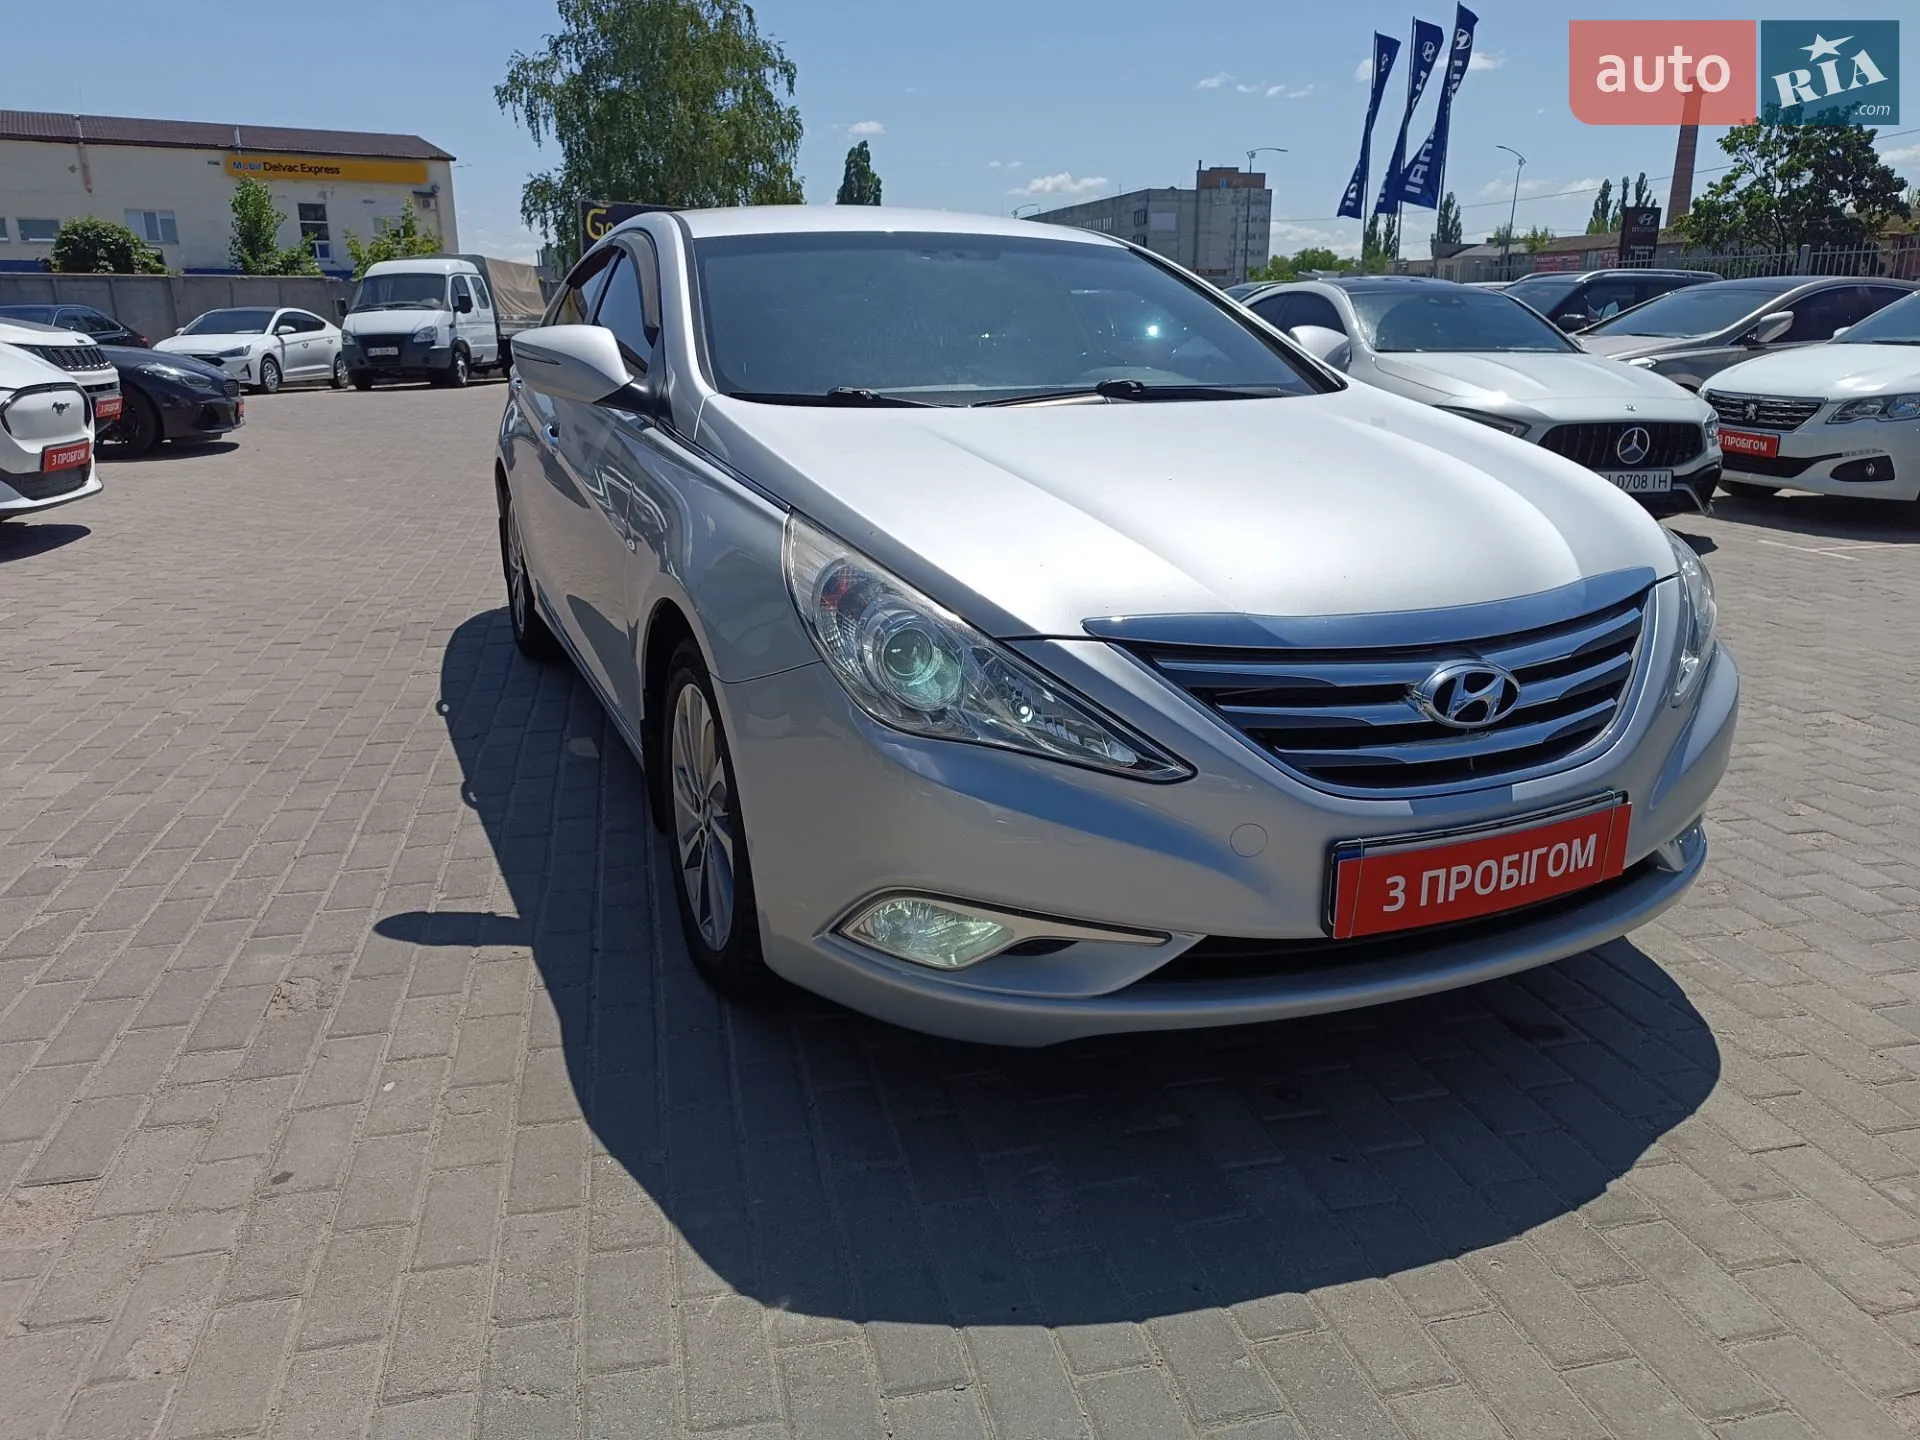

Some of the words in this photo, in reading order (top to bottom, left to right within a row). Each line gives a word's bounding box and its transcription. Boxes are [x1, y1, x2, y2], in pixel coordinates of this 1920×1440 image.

[233, 161, 261, 171] Mobil
[263, 161, 300, 173] Delvac
[300, 162, 341, 175] Express
[1724, 435, 1768, 452] ПРОБІГОМ
[57, 447, 86, 465] ПРОБІГОМ
[1616, 474, 1648, 489] 0708
[1652, 473, 1668, 489] IH
[1382, 875, 1406, 912] З
[1420, 833, 1597, 907] ПРОБІГОМ
